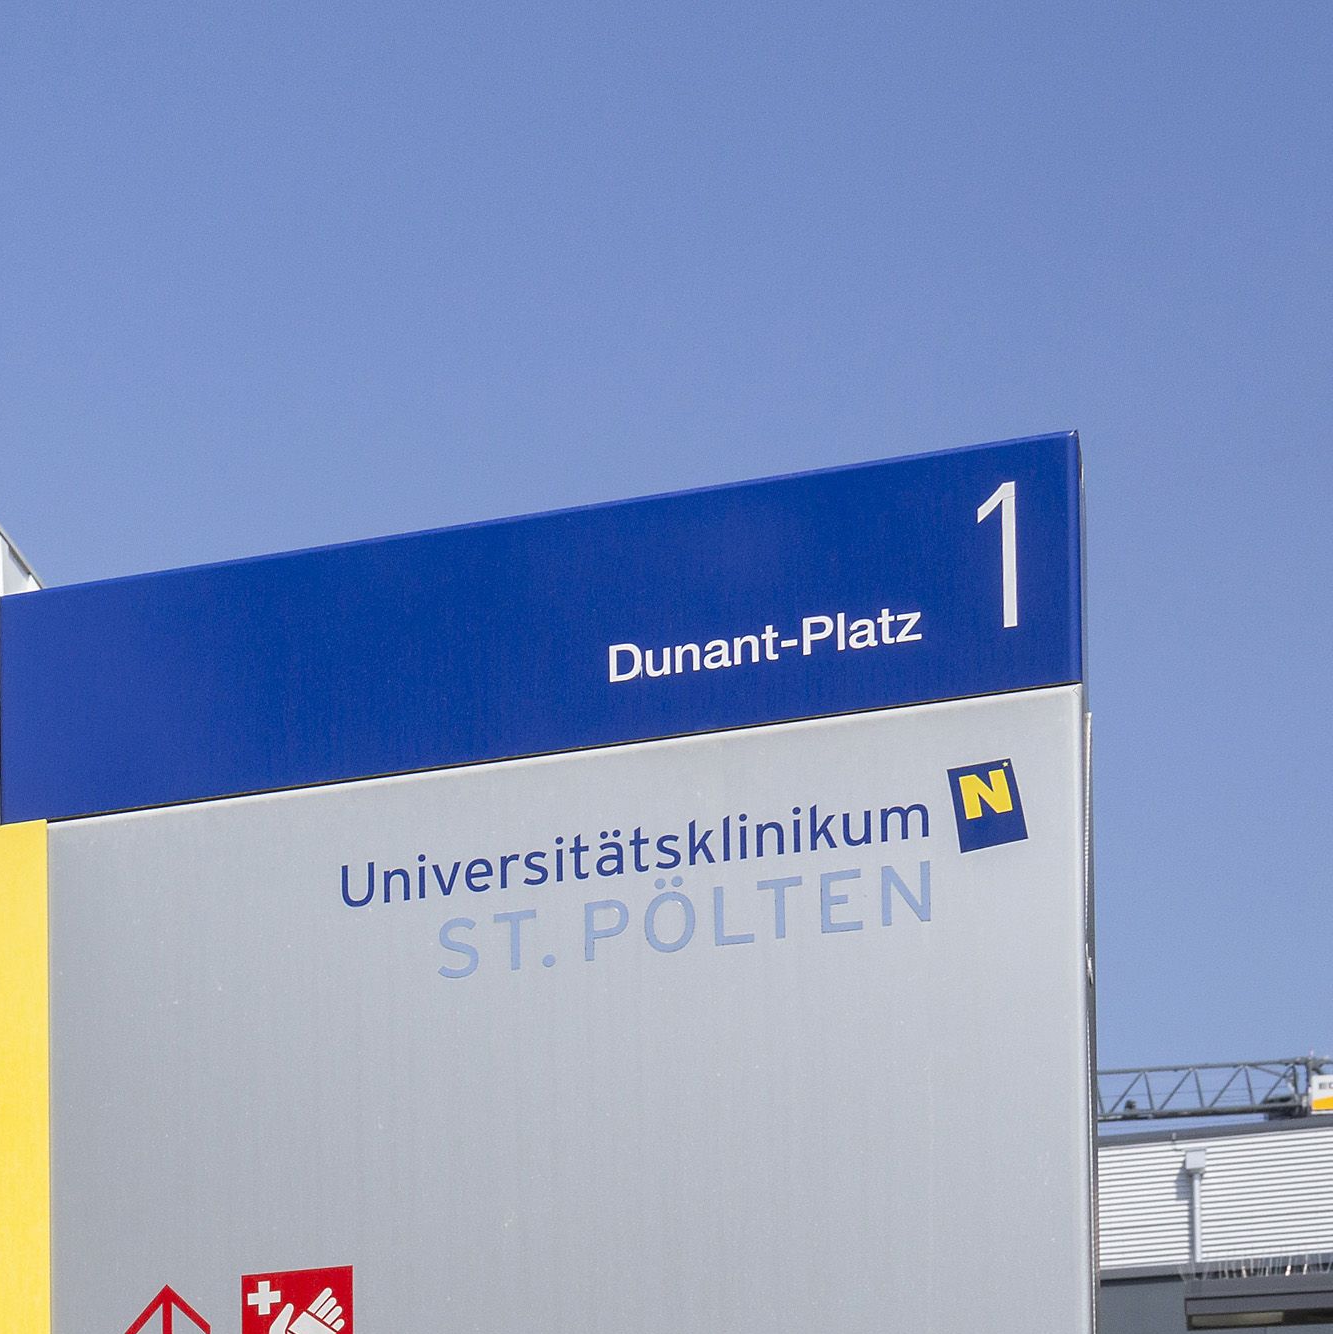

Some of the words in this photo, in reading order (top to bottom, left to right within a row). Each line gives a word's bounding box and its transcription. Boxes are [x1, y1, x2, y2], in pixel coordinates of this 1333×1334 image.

[976, 480, 1019, 629] 1
[608, 607, 924, 684] Dunant-Platz
[340, 803, 930, 909] Universitätsklinikum
[437, 909, 556, 979] ST.
[583, 860, 932, 962] PÖLTEN
